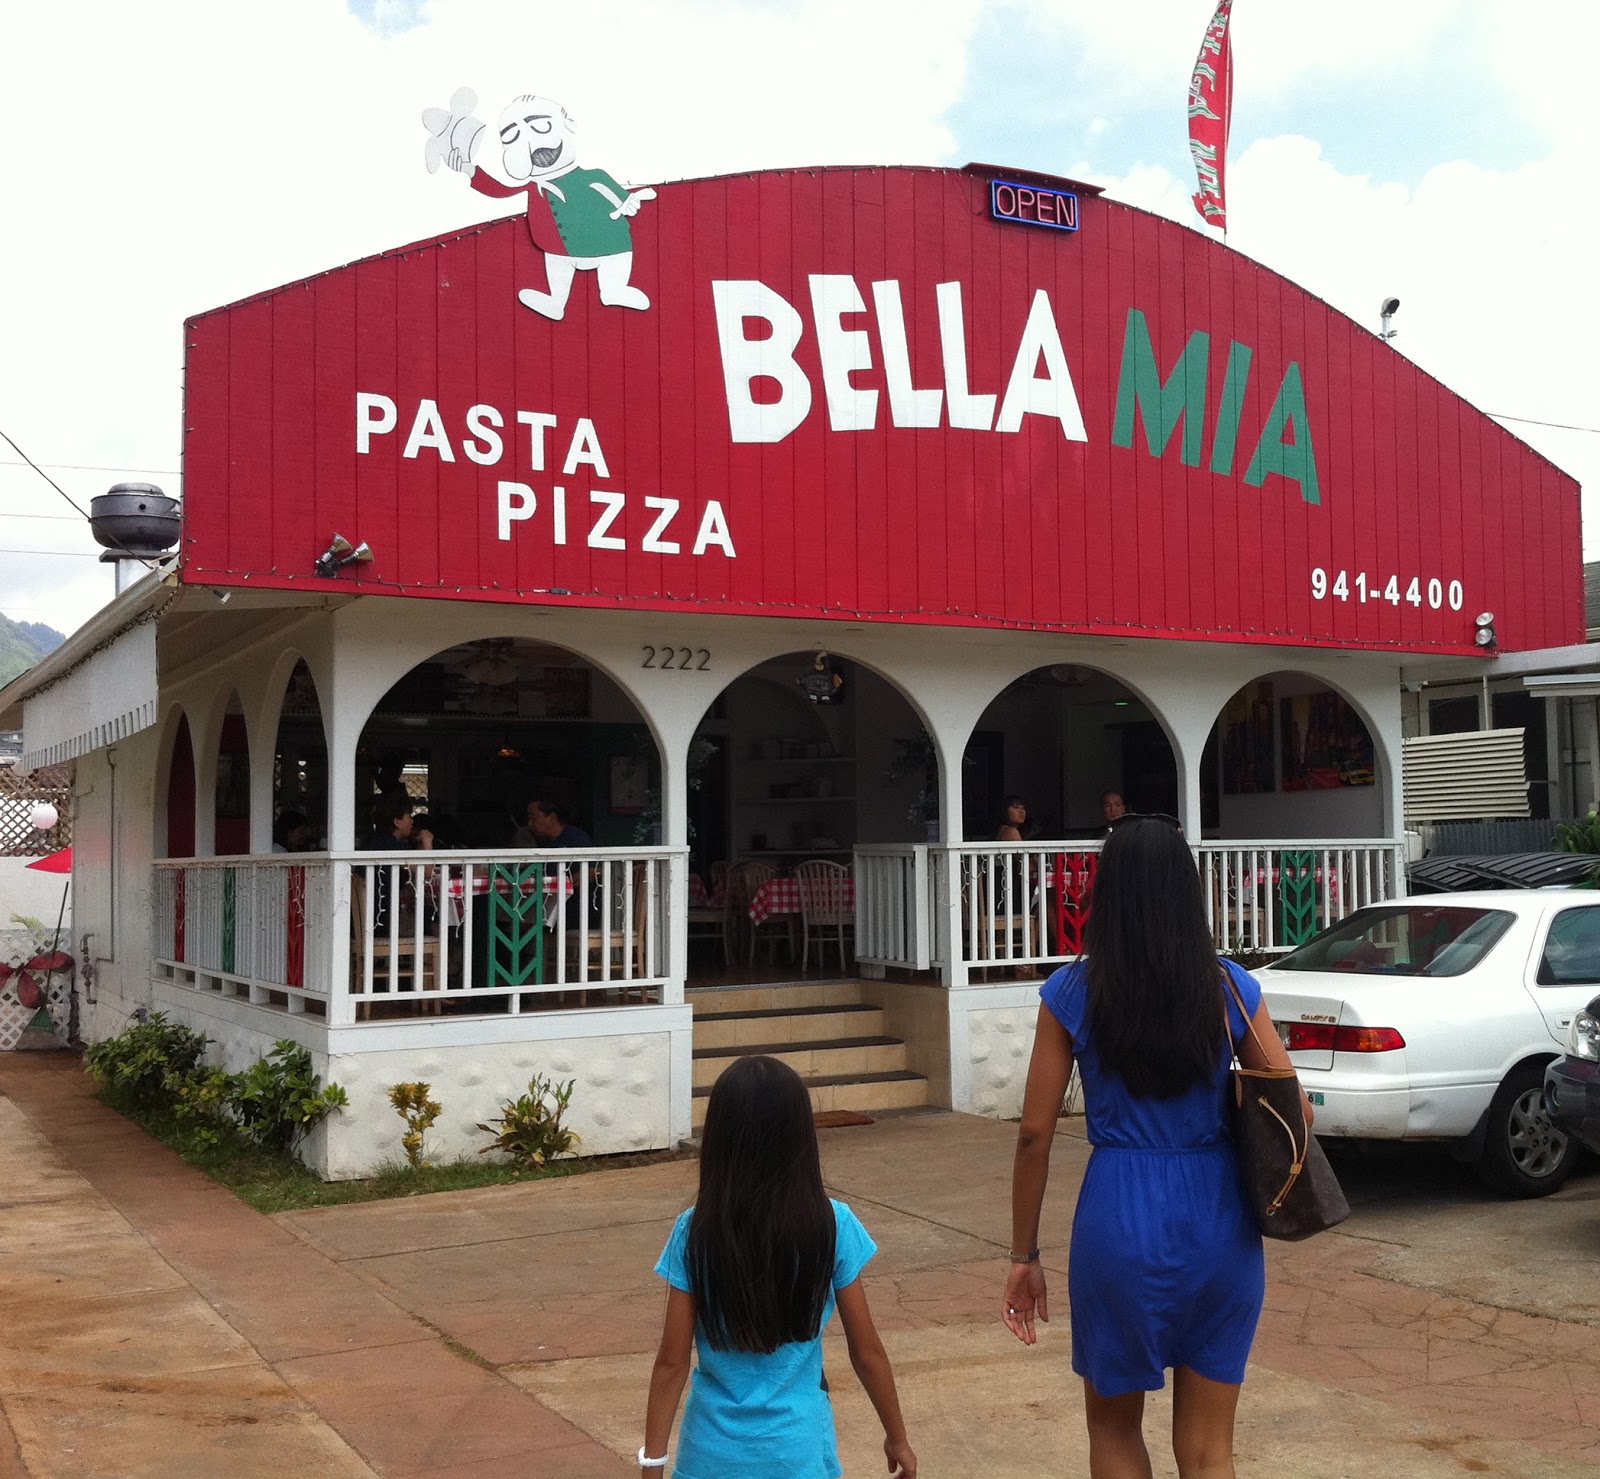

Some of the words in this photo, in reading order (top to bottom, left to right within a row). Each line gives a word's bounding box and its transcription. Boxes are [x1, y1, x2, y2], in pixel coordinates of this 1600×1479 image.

[1188, 0, 1232, 119] ELLA
[996, 185, 1075, 227] OPEN
[711, 273, 1088, 443] BELLA
[1112, 306, 1321, 506] MIA
[356, 392, 610, 478] PASTA
[497, 481, 736, 558] PIZZA
[1311, 567, 1463, 611] 941-4400
[642, 645, 711, 671] 2222
